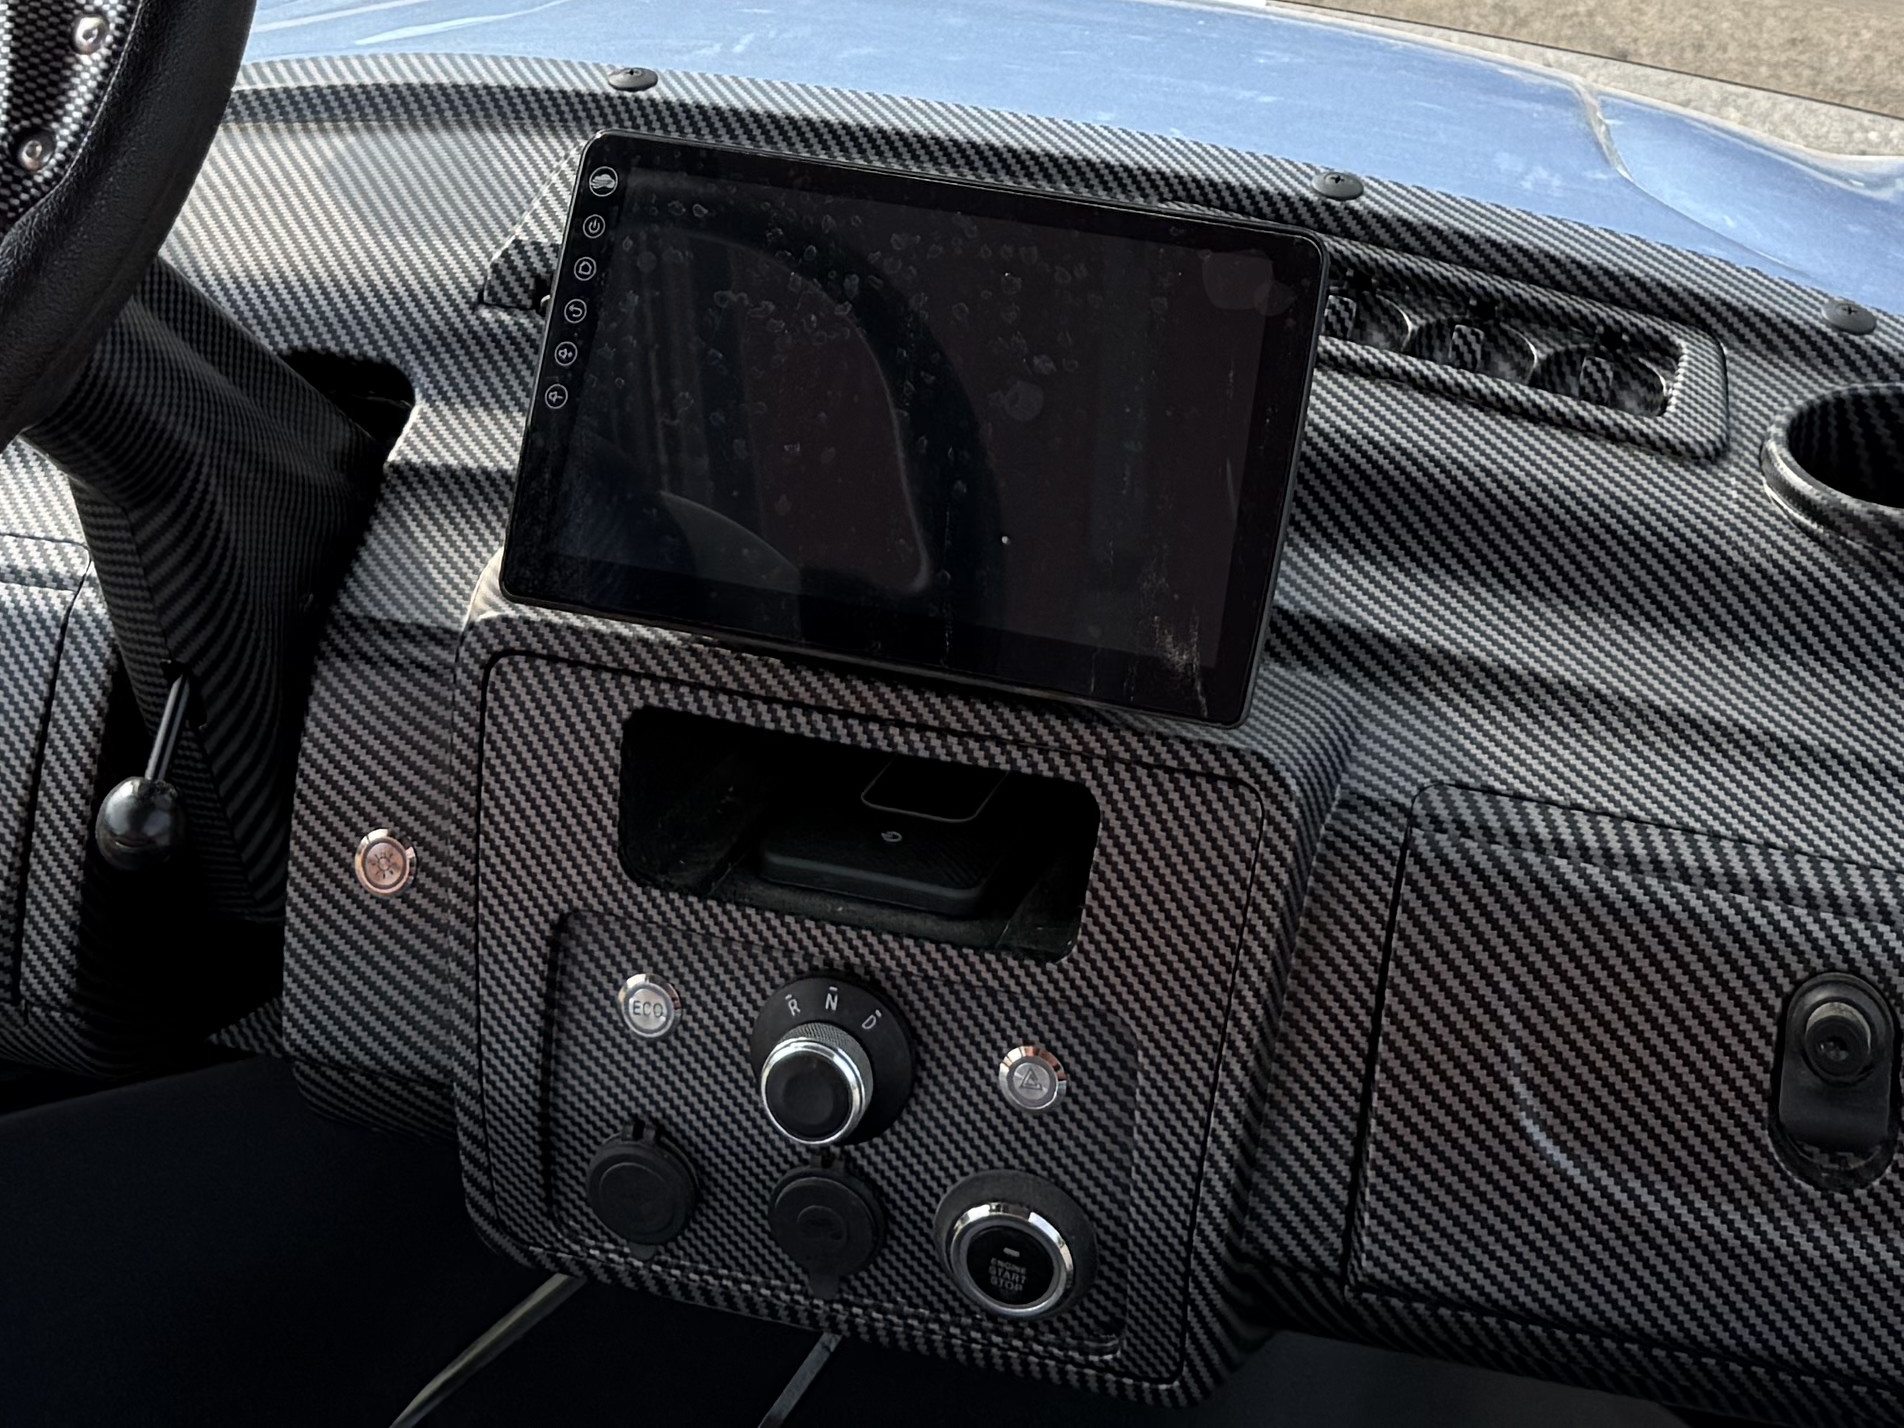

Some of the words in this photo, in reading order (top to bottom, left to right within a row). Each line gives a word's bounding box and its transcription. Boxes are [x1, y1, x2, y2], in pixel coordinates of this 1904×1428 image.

[633, 1001, 663, 1018] ECO
[788, 998, 801, 1016] R
[825, 993, 838, 1011] N
[861, 1014, 877, 1030] D
[988, 1265, 1027, 1284] START
[990, 1276, 1023, 1291] STOP
